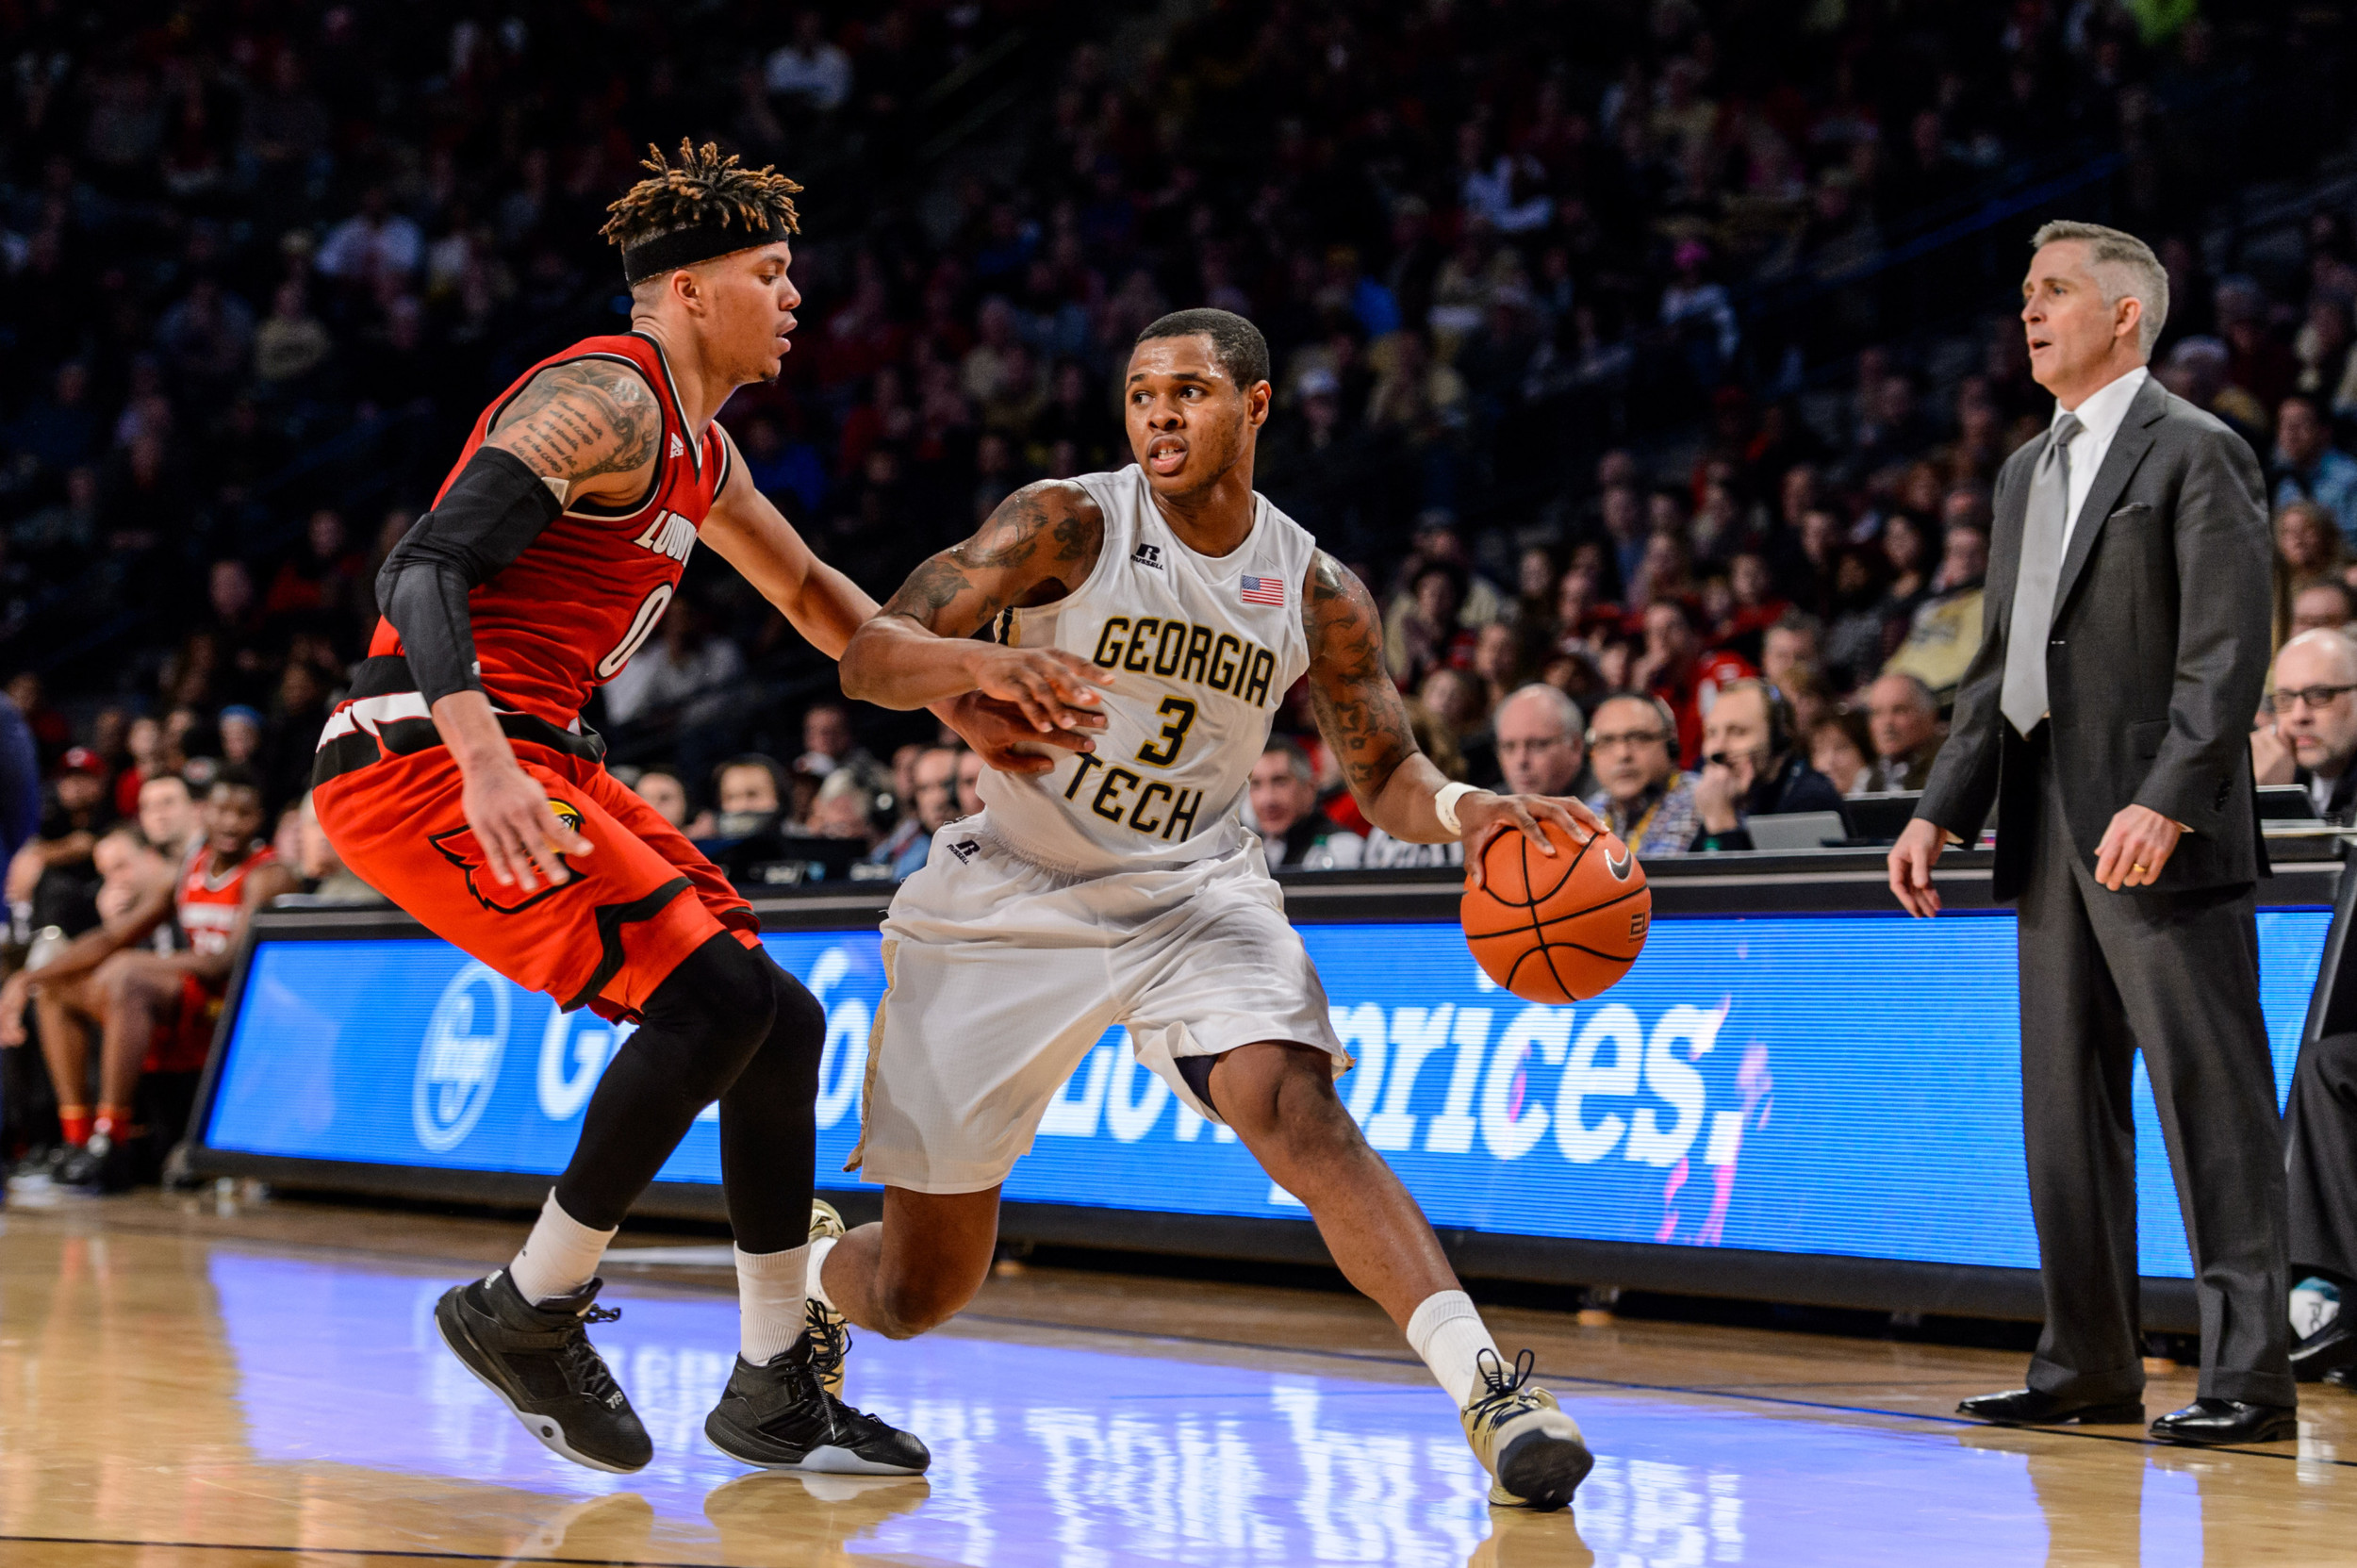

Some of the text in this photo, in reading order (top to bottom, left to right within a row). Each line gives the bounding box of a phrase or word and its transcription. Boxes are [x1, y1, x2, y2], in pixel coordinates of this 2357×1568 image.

[1130, 553, 1163, 570] RUSSELL
[594, 580, 672, 680] 0
[1093, 615, 1277, 709] GEORGIA
[1134, 694, 1198, 768] 3
[1063, 751, 1204, 844] TECH
[946, 844, 969, 865] RUSSELL
